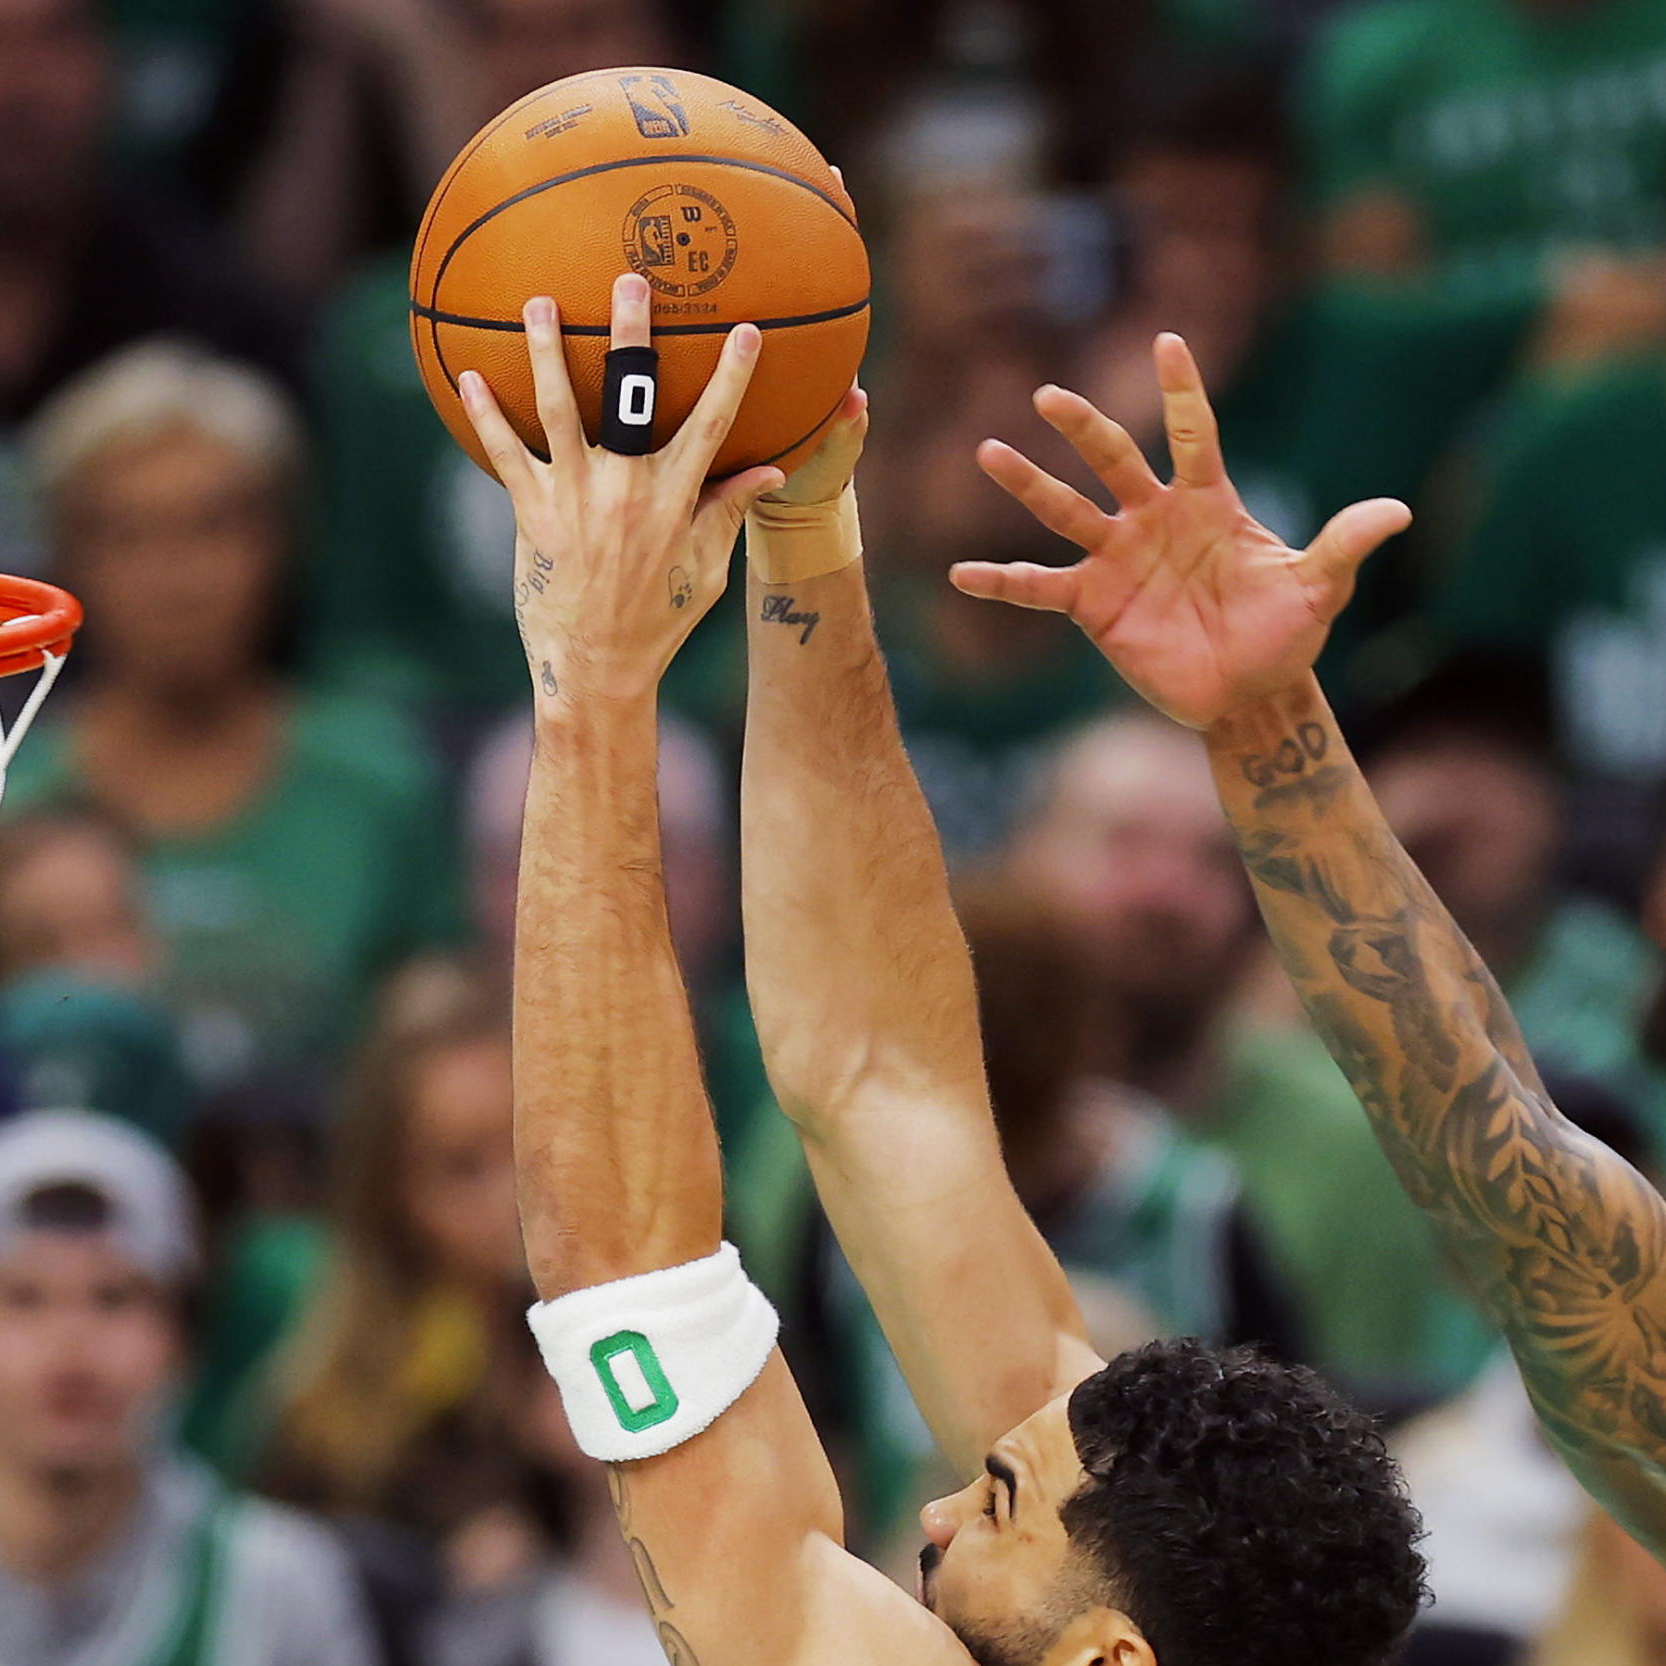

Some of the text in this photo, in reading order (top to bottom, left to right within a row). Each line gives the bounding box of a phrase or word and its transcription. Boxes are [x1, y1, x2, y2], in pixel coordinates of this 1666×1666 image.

[688, 250, 710, 273] EC
[618, 374, 655, 426] 0
[527, 549, 554, 595] Big
[760, 594, 822, 646] Play
[1240, 721, 1328, 787] GOD
[589, 1329, 680, 1434] 0
